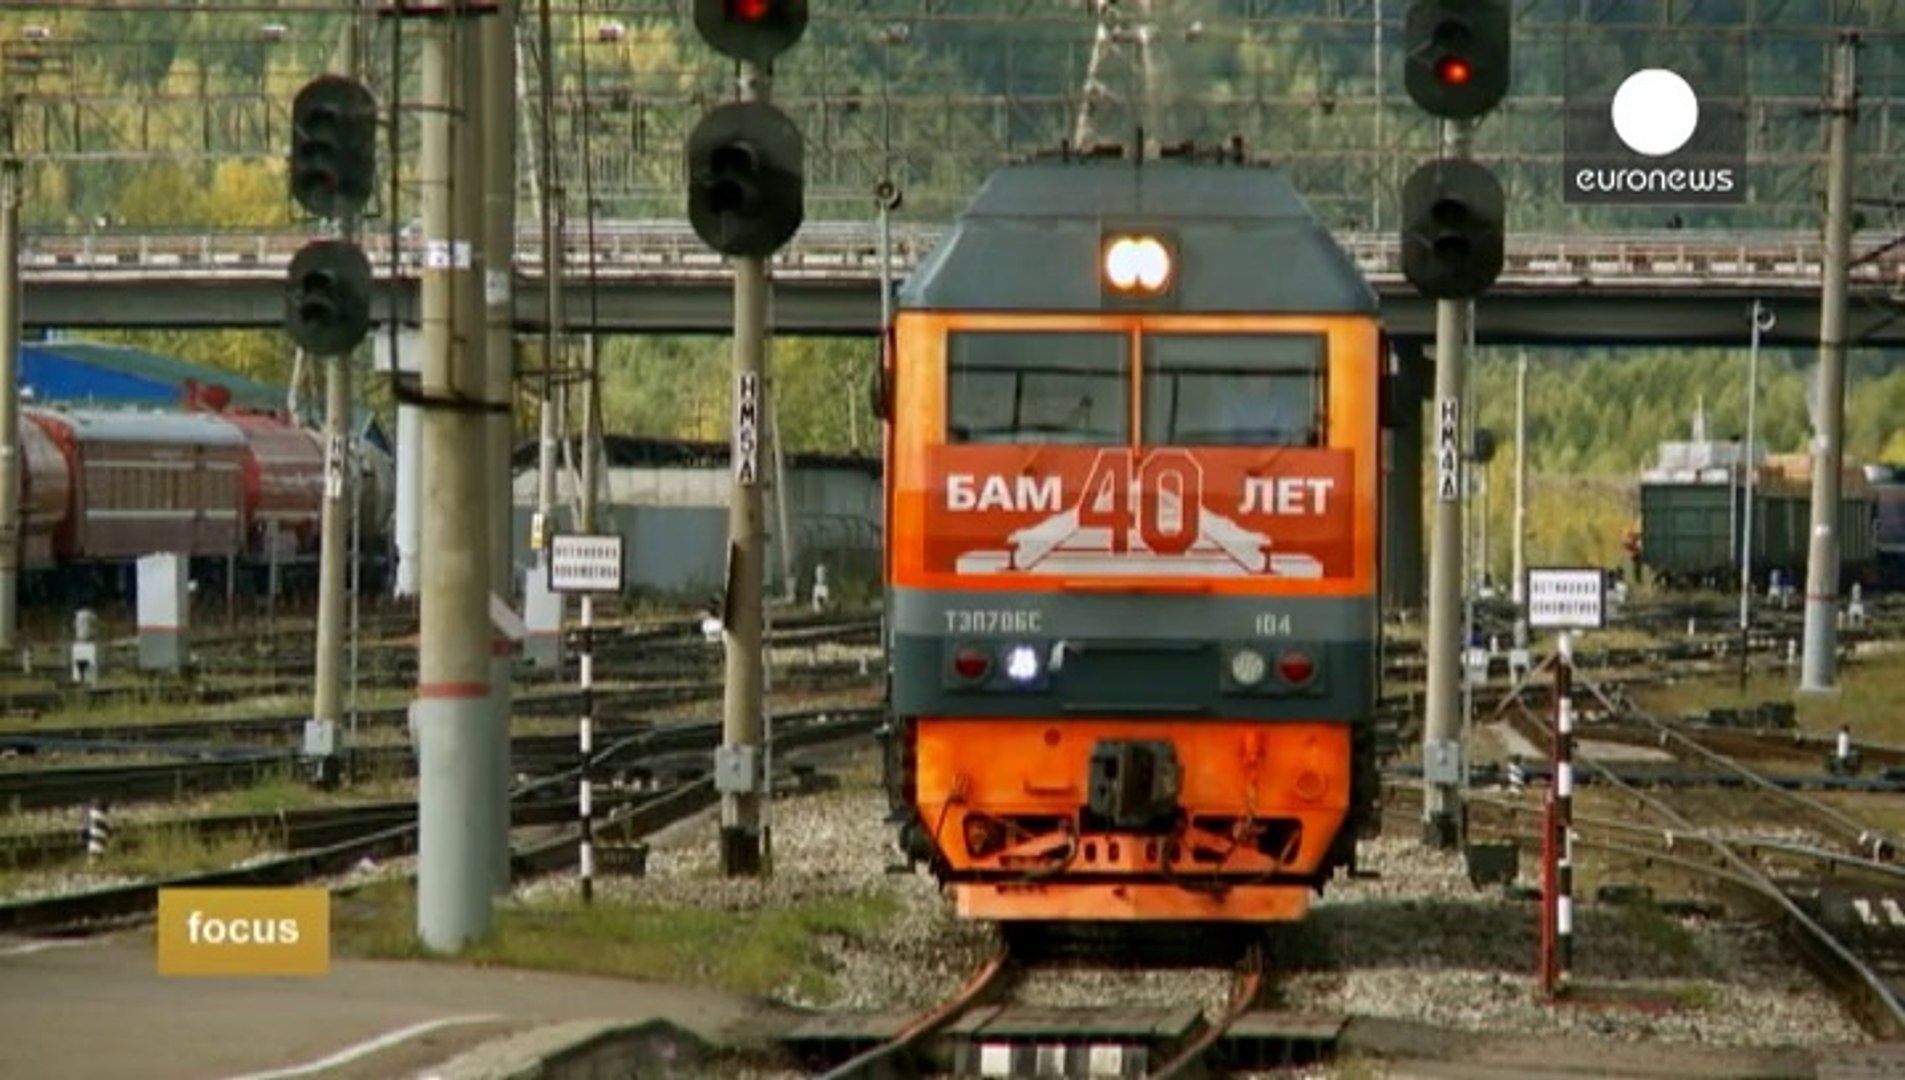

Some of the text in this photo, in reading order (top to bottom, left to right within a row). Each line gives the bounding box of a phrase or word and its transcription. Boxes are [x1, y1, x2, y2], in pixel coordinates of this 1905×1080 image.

[946, 448, 1335, 556] БАМ 40 ЛЕТ
[945, 609, 1042, 632] ТЭП70БС
[1255, 613, 1292, 636] 104
